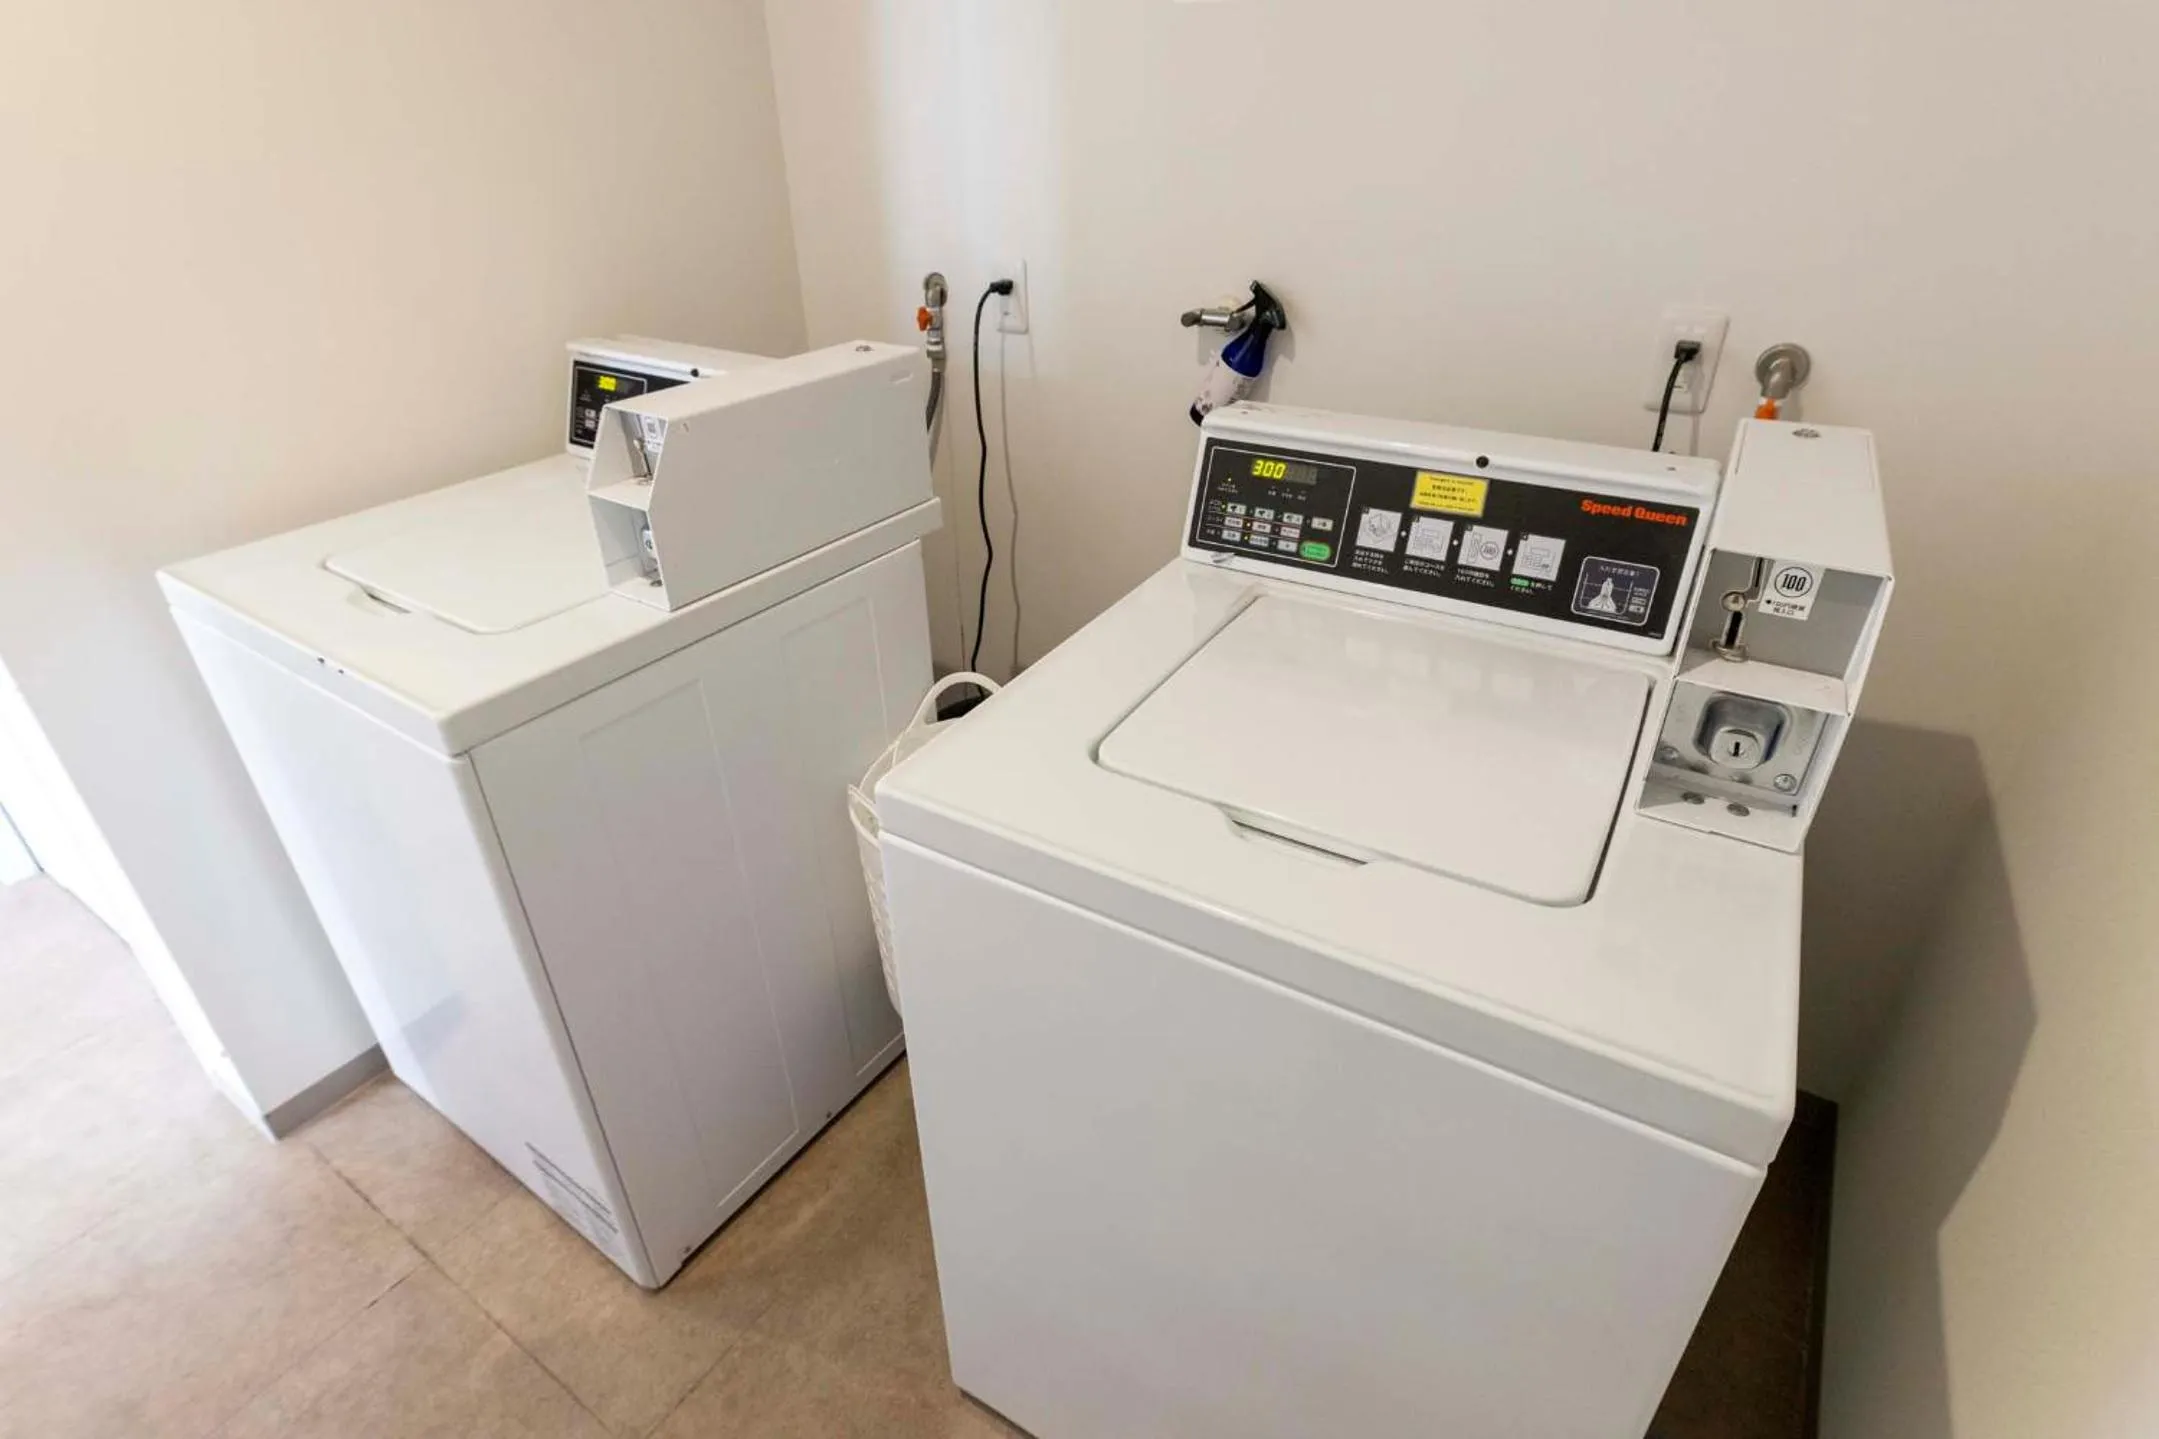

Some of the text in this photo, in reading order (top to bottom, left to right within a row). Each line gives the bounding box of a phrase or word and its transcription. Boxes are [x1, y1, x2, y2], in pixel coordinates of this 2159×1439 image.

[1252, 459, 1287, 481] 300
[1581, 499, 1689, 526] Speed Queen
[1781, 573, 1807, 592] 100
